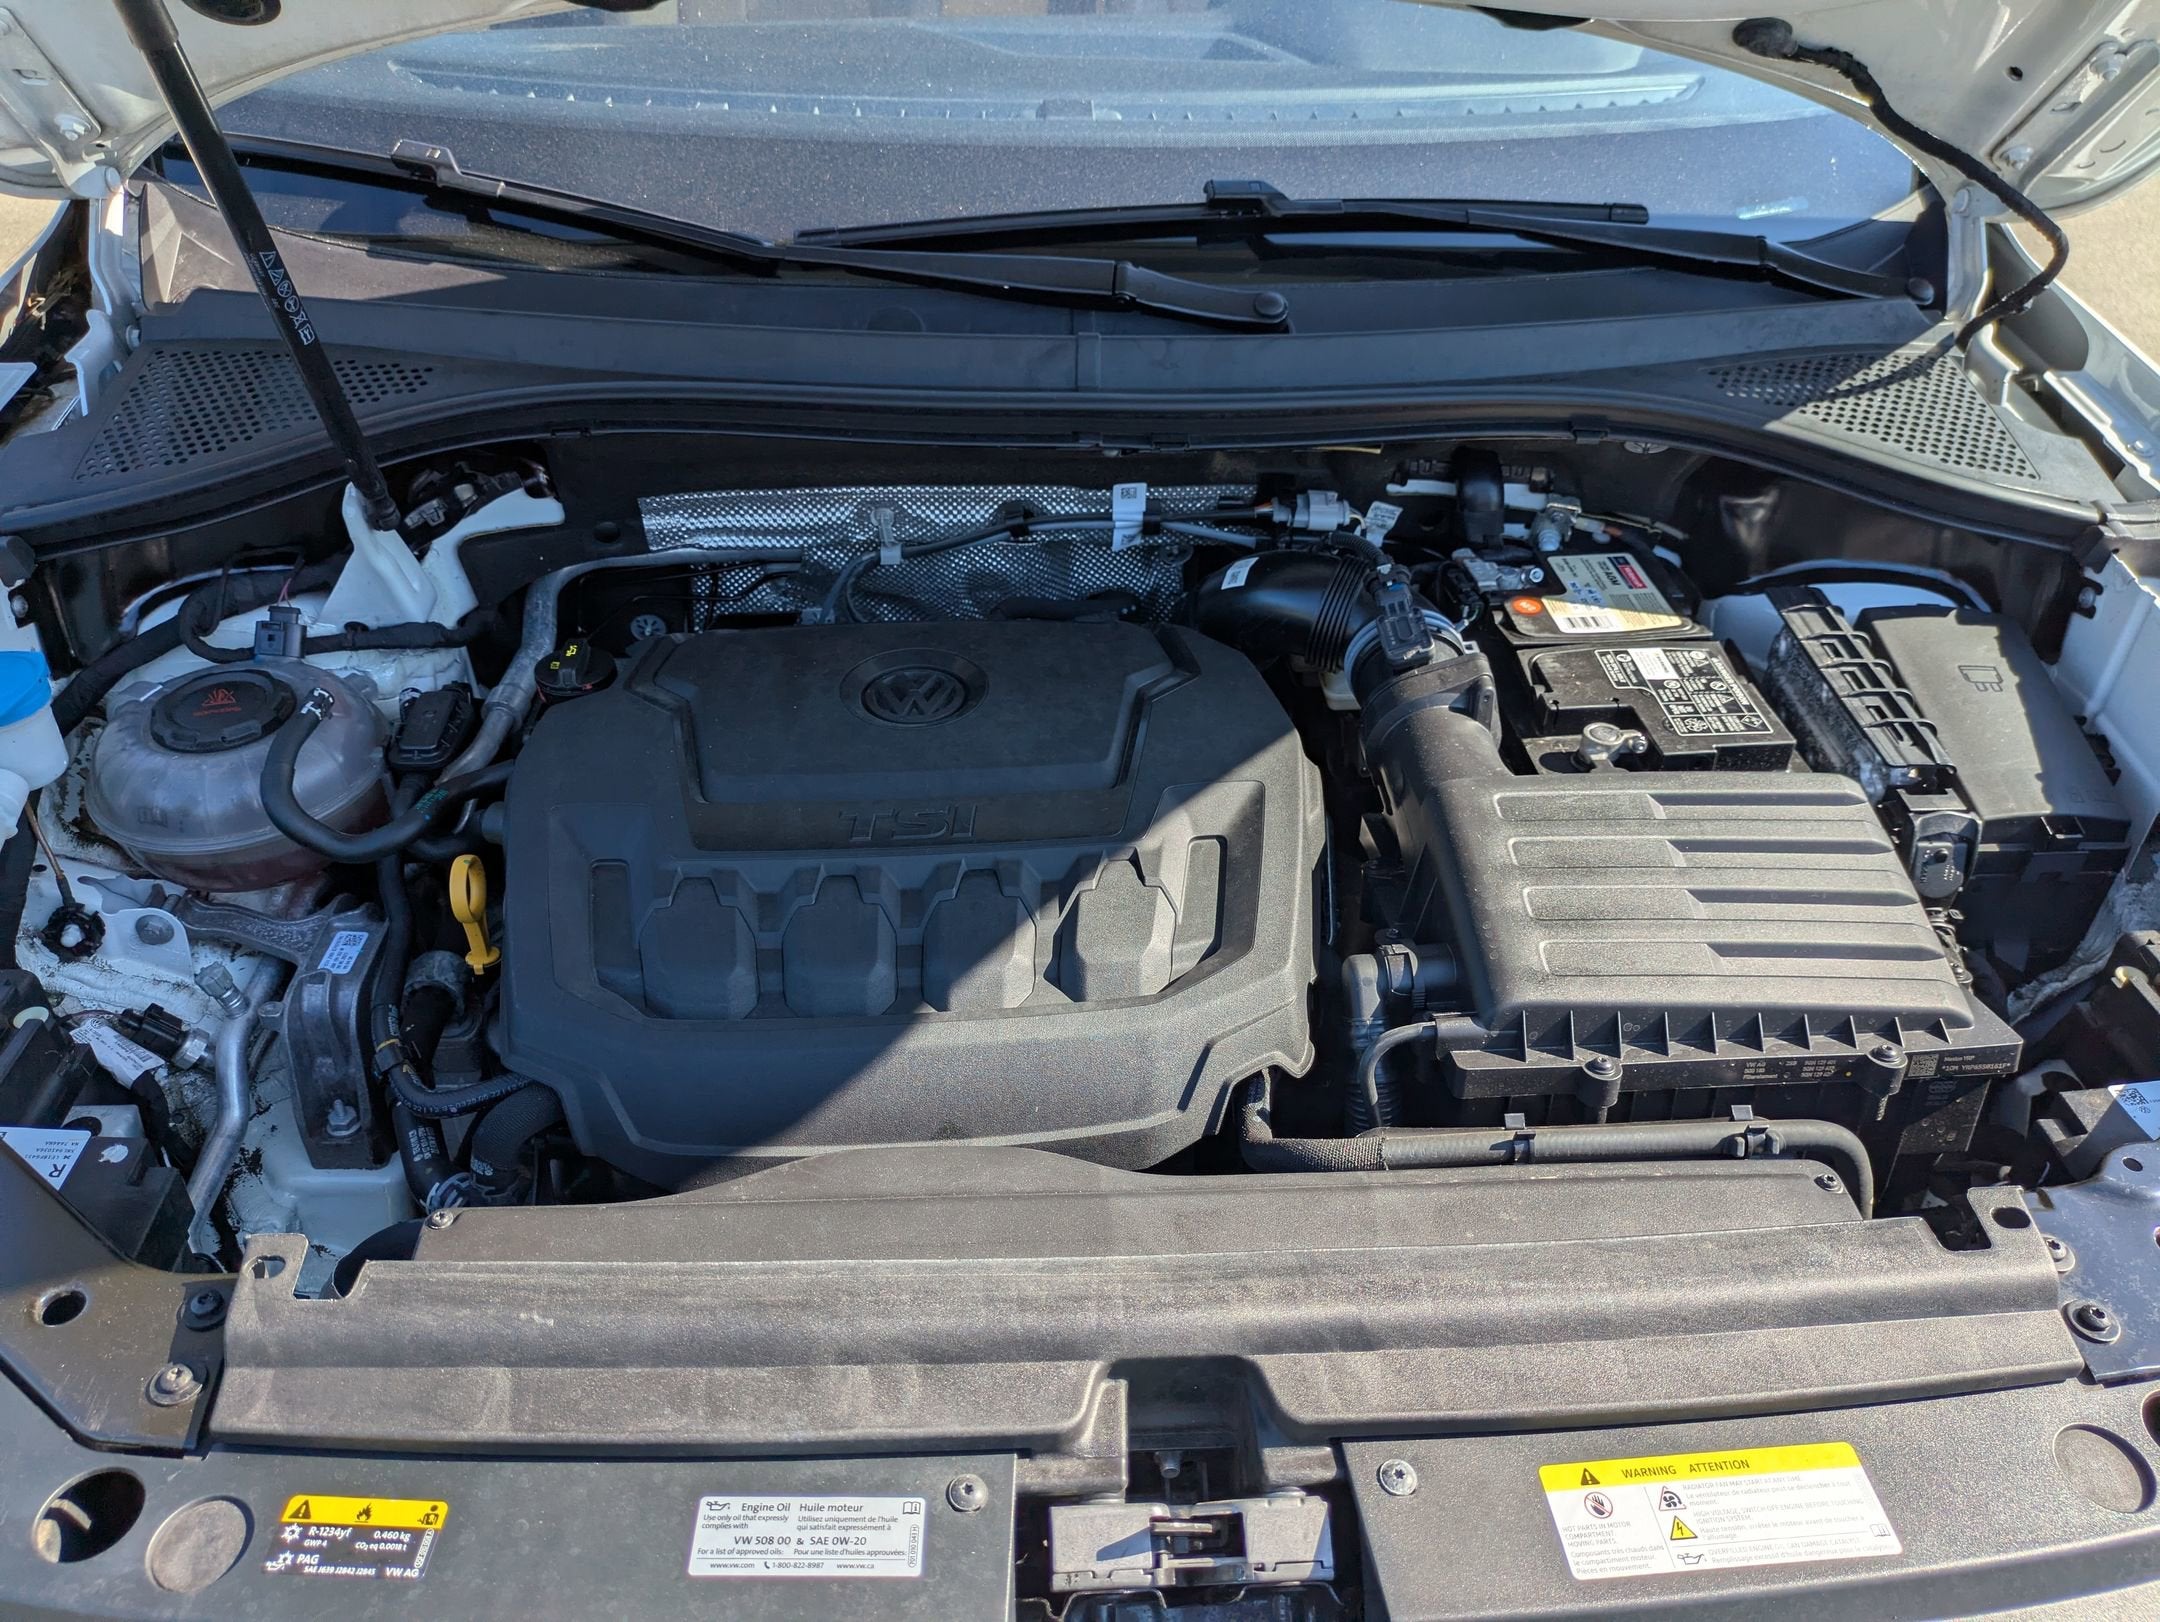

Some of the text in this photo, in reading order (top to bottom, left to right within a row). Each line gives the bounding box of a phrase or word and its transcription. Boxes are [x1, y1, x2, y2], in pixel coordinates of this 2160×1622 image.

[839, 804, 978, 840] TSI
[1621, 1459, 1750, 1478] WARNING ATTENTION
[742, 1503, 791, 1514] Engine Oil
[799, 1504, 863, 1512] Huile moteur
[715, 1514, 731, 1522] only
[702, 1522, 731, 1530] complies
[842, 1524, 885, 1532] expressément
[308, 1526, 352, 1539] R-1234yf
[373, 1531, 411, 1542] 0.460 kg
[304, 1539, 328, 1547] GWP 4
[734, 1536, 867, 1545] VW 508 00 & SAE 0W-20
[736, 1548, 768, 1556] approved
[841, 1548, 865, 1556] d'huiles
[297, 1554, 319, 1564] PAG
[318, 1566, 334, 1574] J639
[335, 1567, 355, 1575] J2842
[385, 1568, 419, 1577] VW AG
